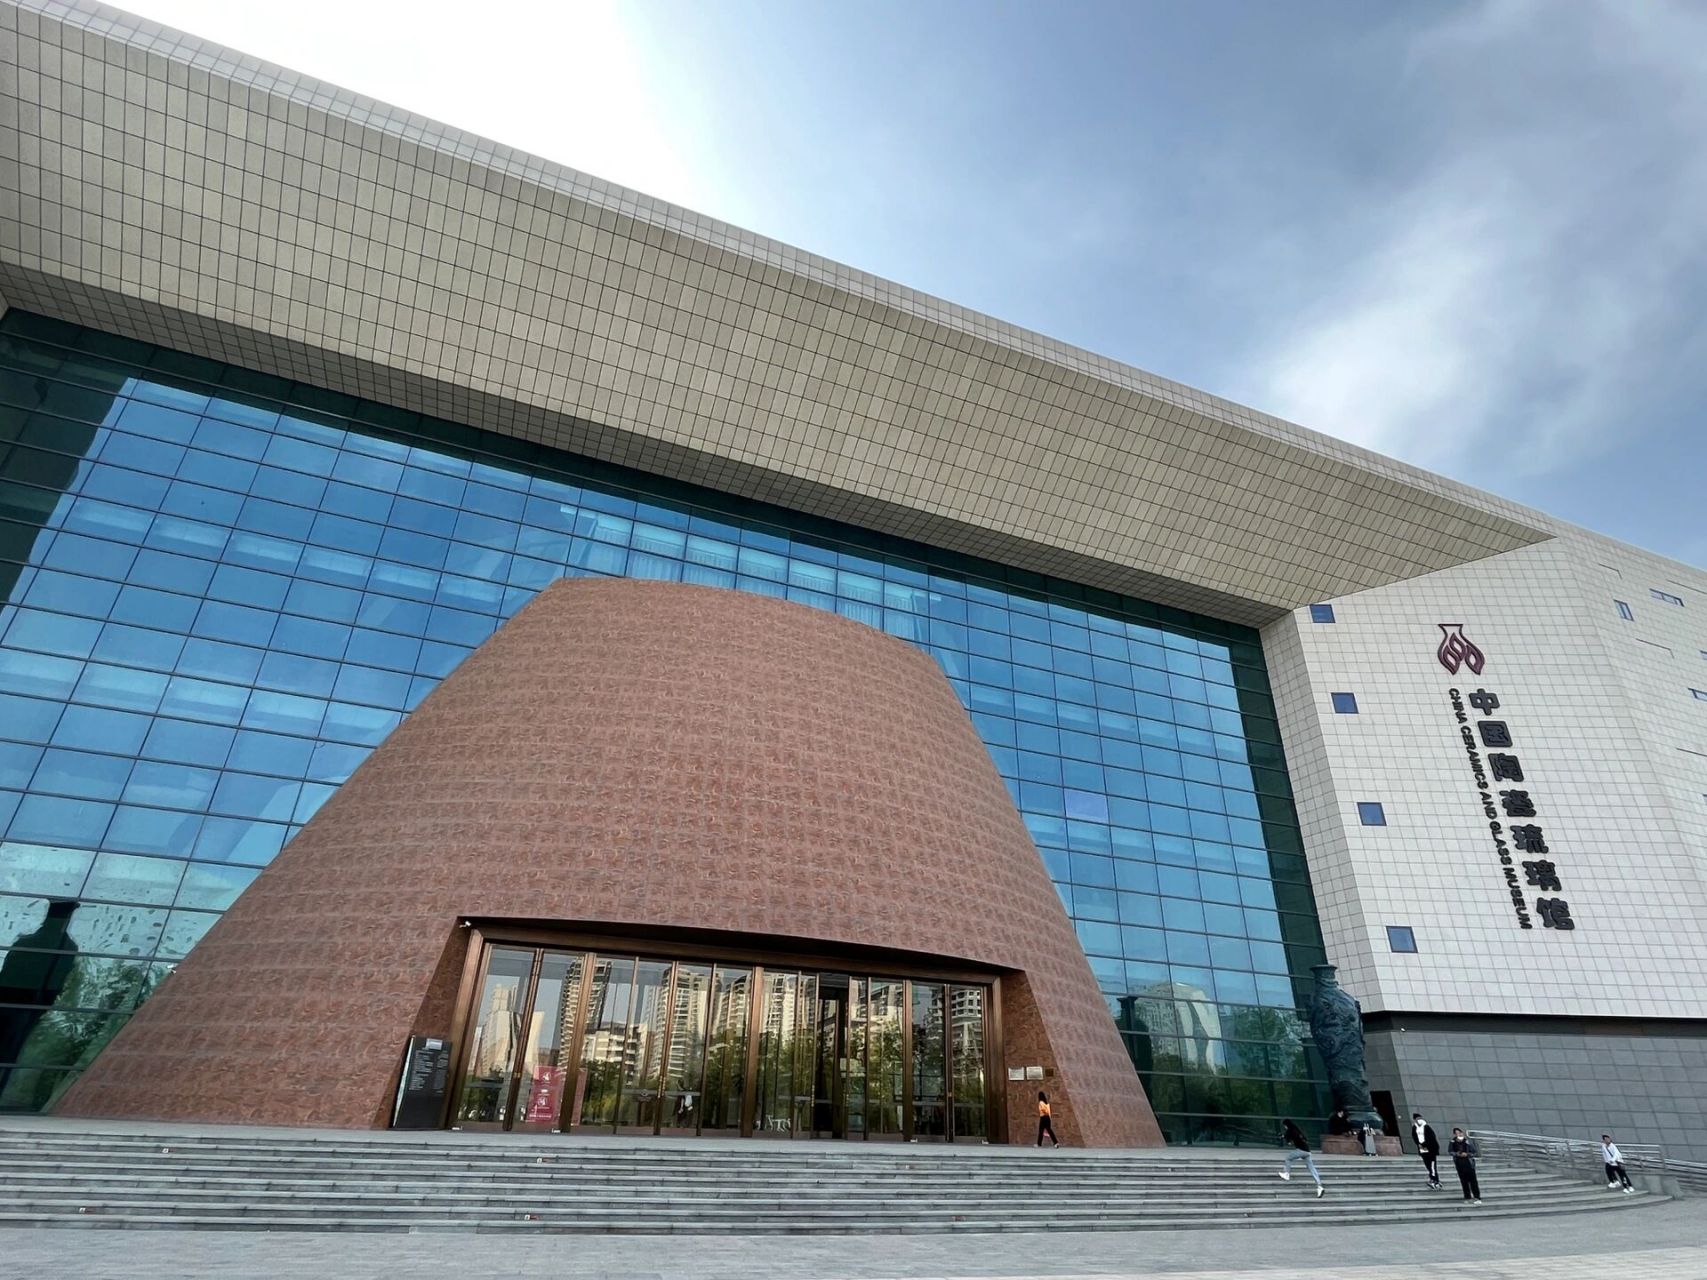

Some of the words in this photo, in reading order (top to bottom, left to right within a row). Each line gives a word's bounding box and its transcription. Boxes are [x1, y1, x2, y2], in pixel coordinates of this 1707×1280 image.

[1448, 687, 1468, 724] CHINA
[1460, 726, 1489, 790] CERAMICS
[1479, 792, 1498, 820] AND
[1489, 821, 1513, 866] GLASS
[1502, 867, 1533, 930] MUSEUM
